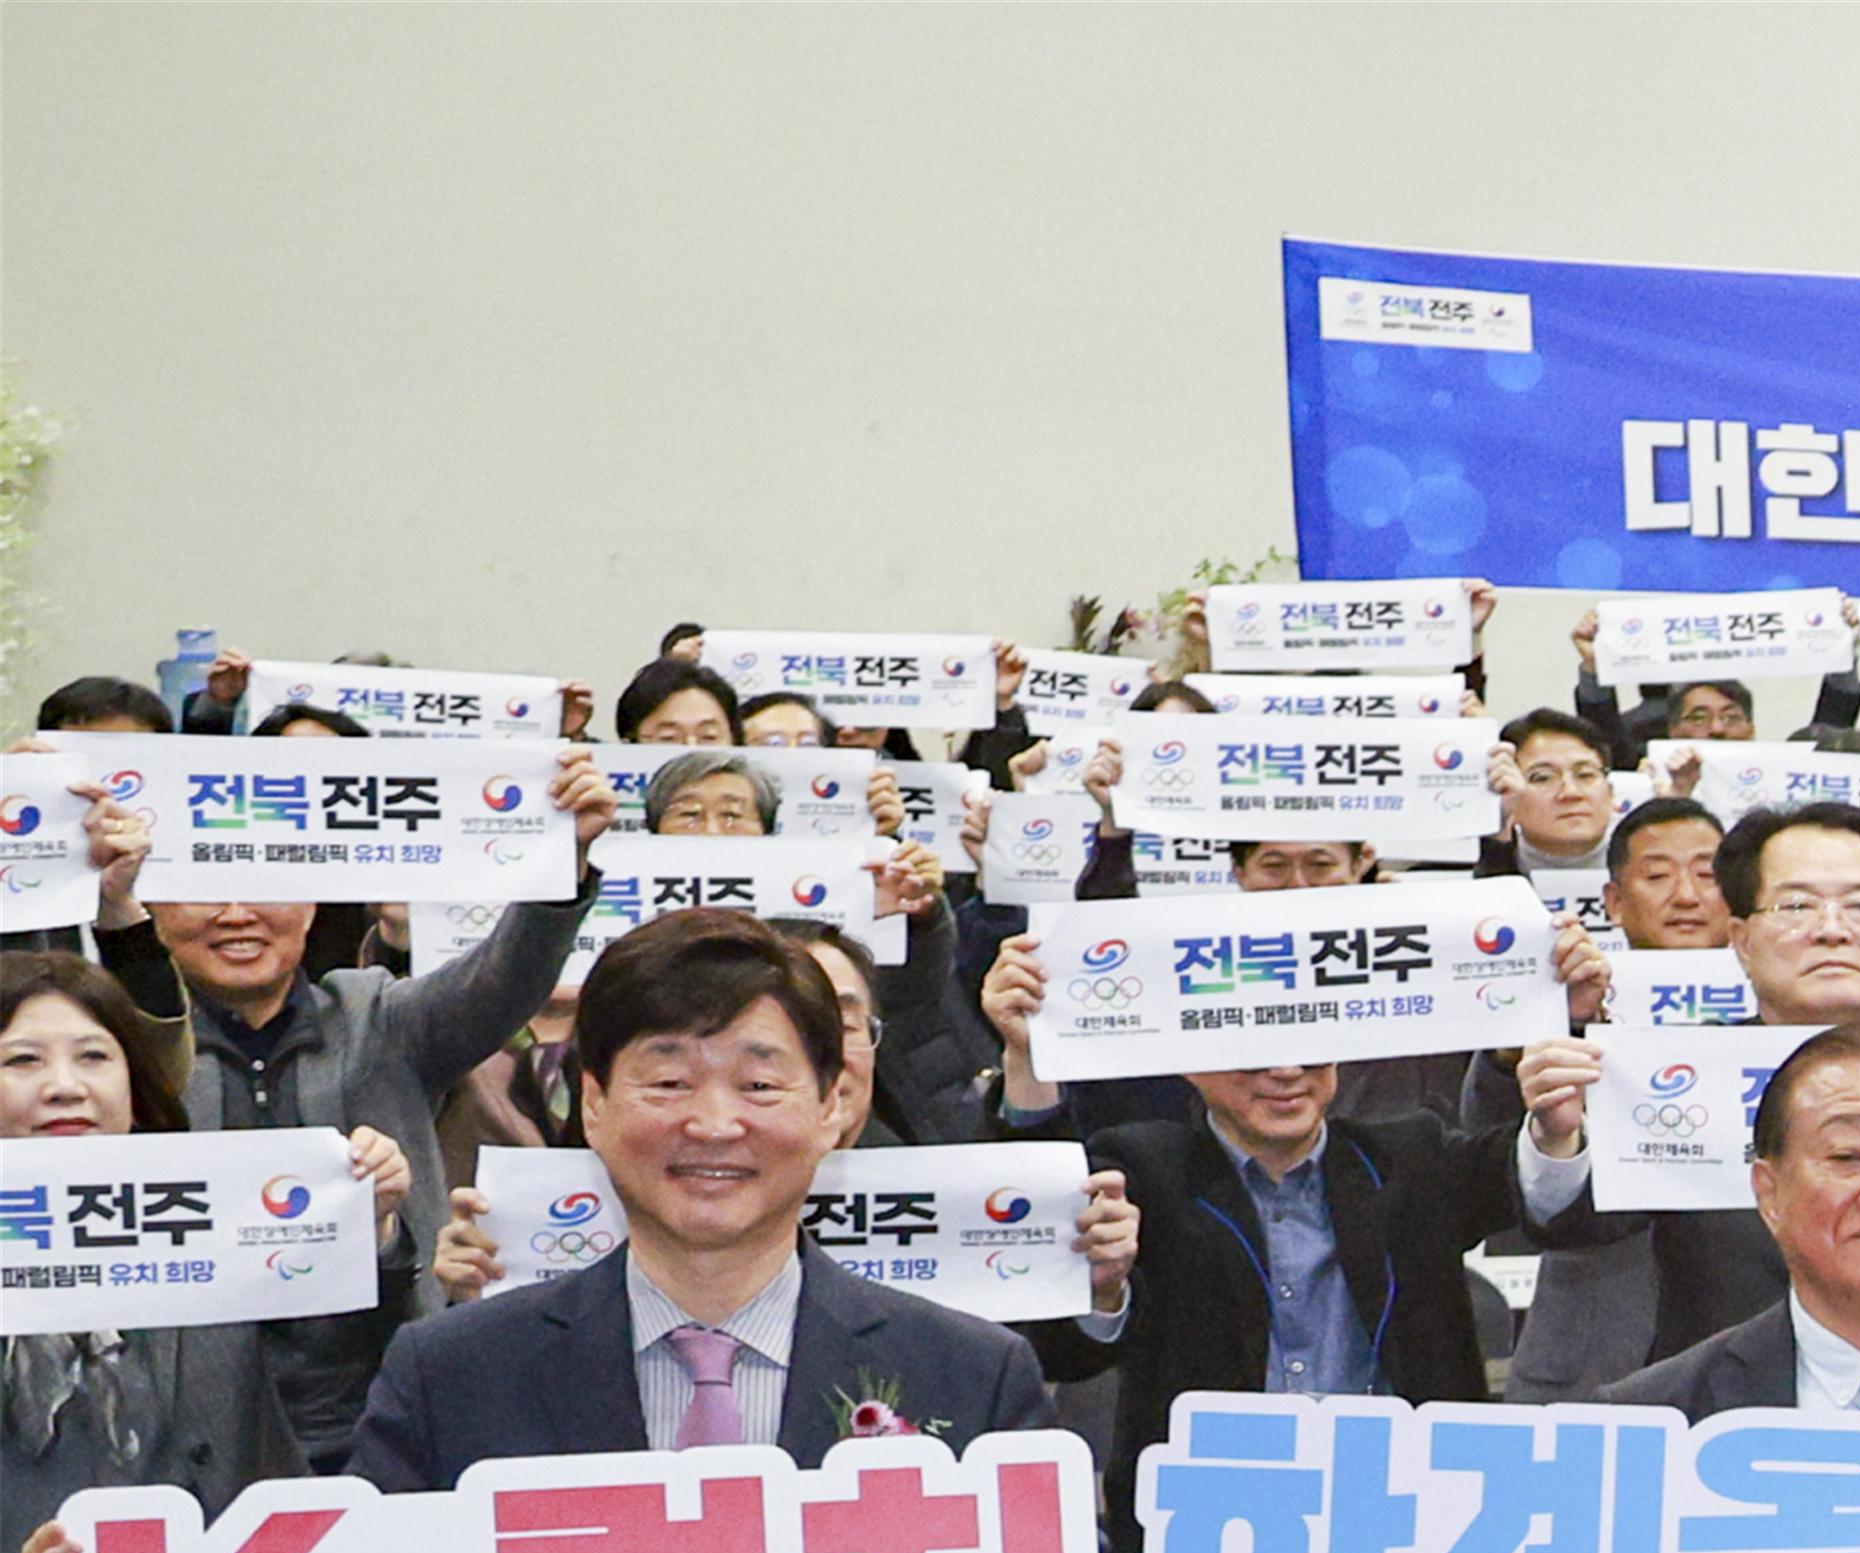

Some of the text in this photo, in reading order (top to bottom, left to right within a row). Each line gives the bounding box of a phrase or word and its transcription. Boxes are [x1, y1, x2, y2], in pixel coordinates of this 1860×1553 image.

[1381, 296, 1473, 321] 전북 전주
[1281, 602, 1403, 632] 전북 전주
[1664, 613, 1784, 645] 전북 전주
[781, 656, 919, 687] 전북 전주
[1027, 670, 1087, 700] 전주
[336, 689, 481, 725] 전북 전주
[1218, 744, 1403, 786] 전북 전주
[188, 775, 441, 831] 전북 전주
[192, 843, 442, 864] 올림픽·패럴림픽 유치 희망
[1174, 925, 1432, 995] 전북 전주
[1181, 995, 1434, 1030] 올림픽·패럴림픽 유치 희망
[67, 1181, 213, 1248] 전주
[806, 1192, 938, 1246] 전주
[109, 1261, 215, 1286] 유치 희망
[891, 1259, 938, 1280] 희망
